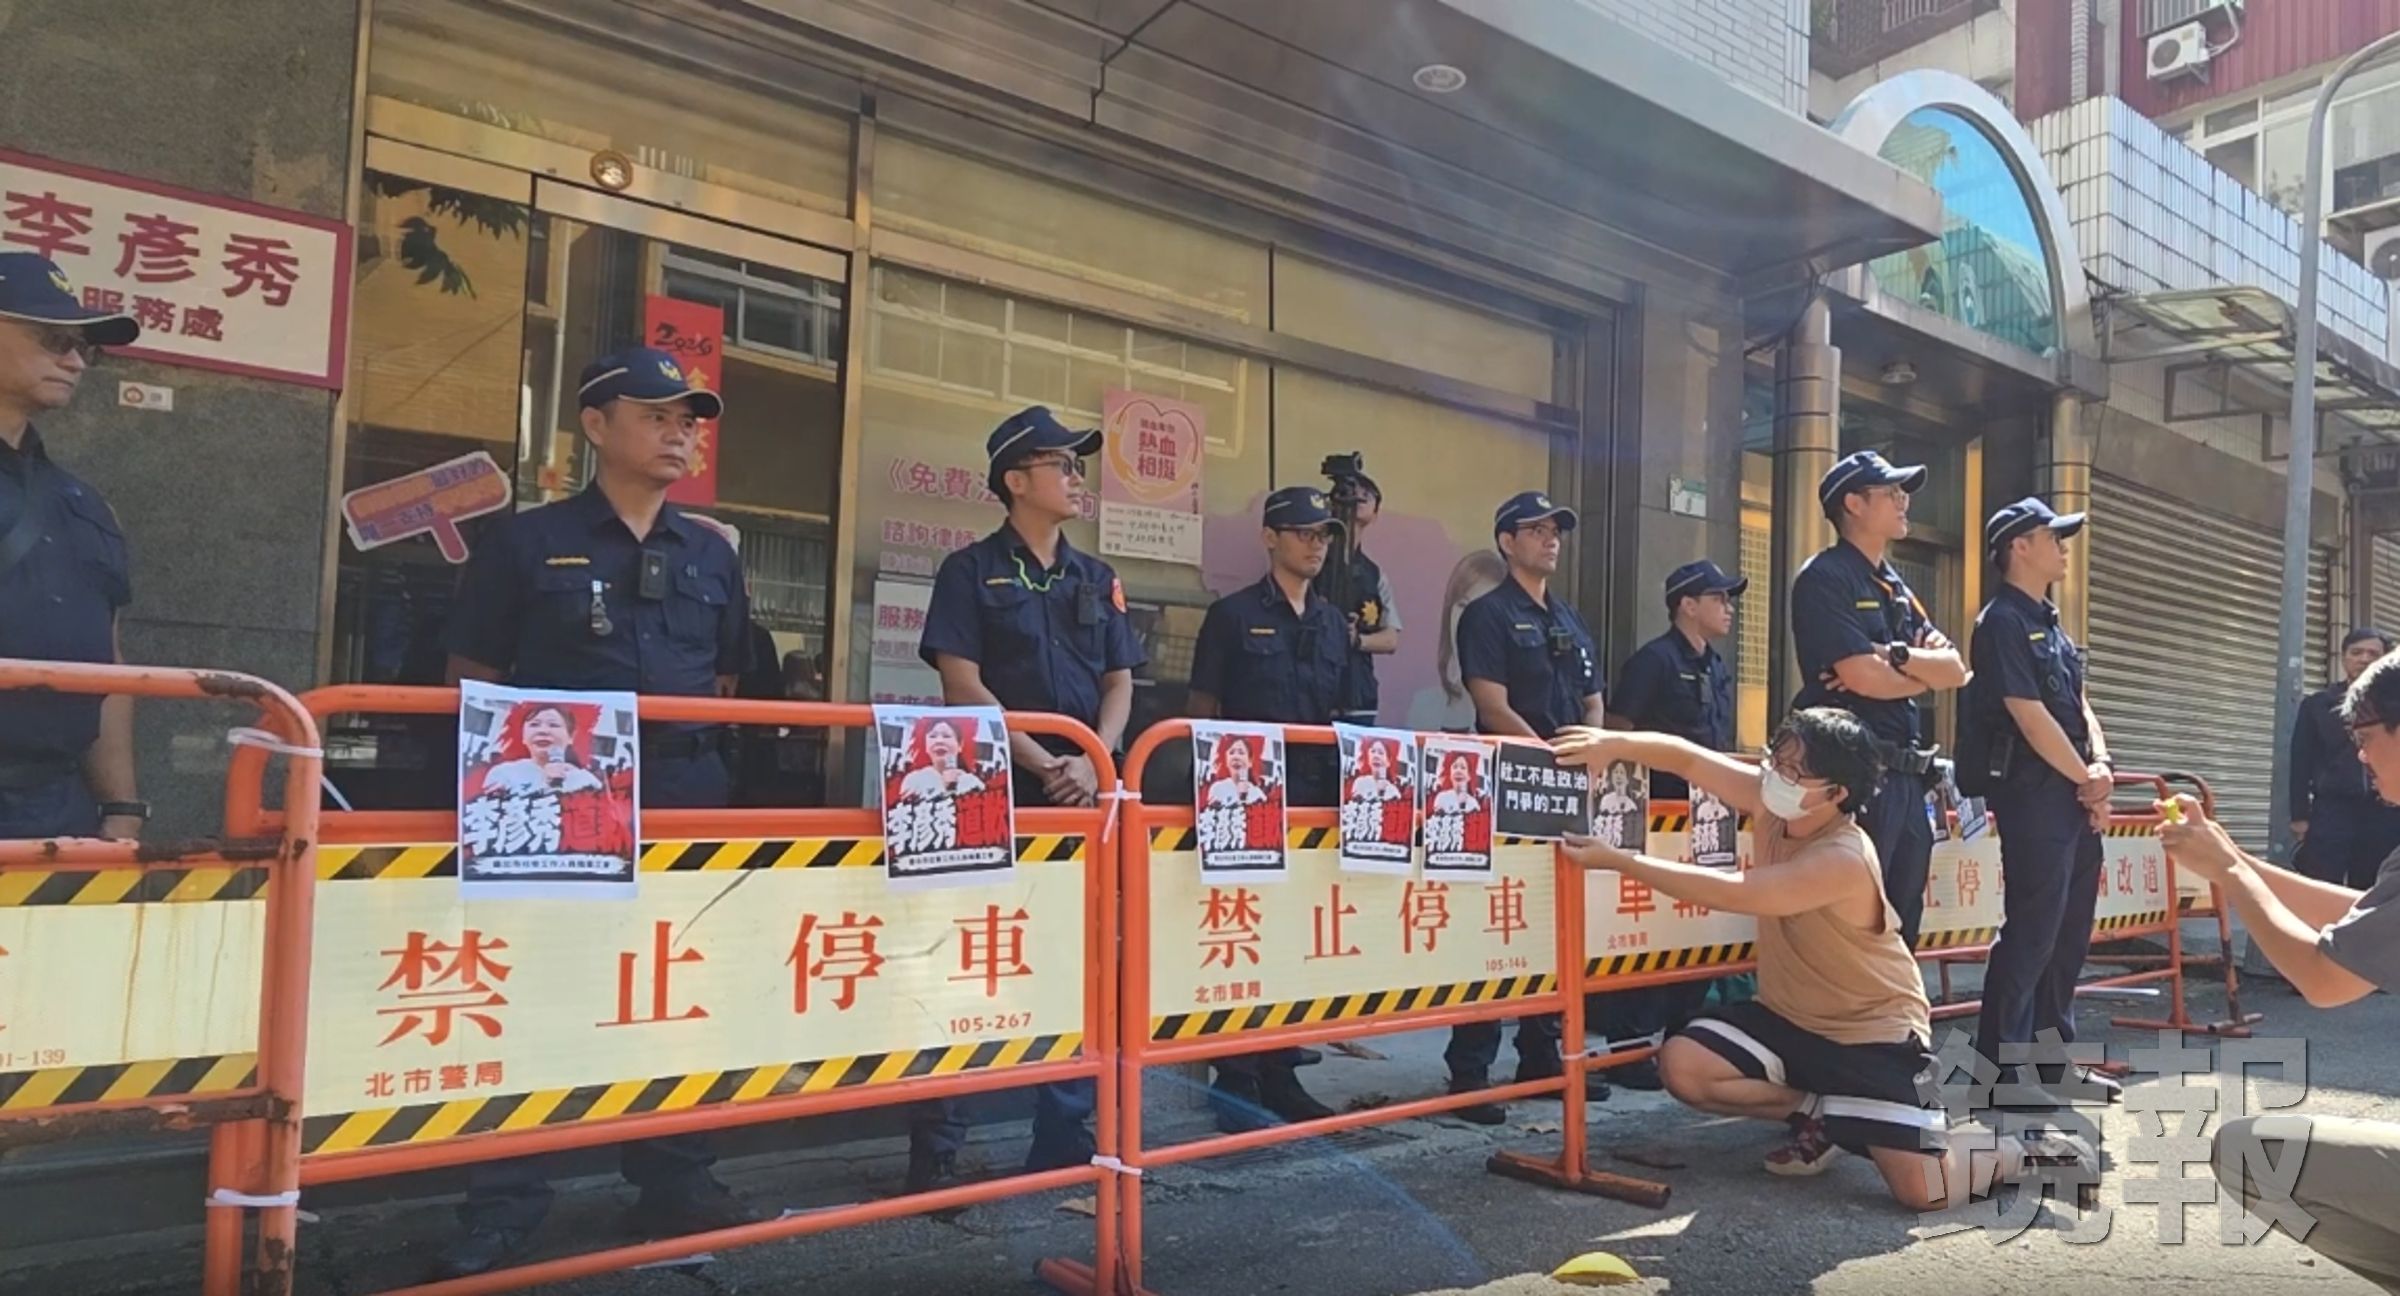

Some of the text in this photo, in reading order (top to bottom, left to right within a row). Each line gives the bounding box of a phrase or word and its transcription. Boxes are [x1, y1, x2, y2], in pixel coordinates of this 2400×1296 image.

[3, 192, 299, 307] 李彥秀
[83, 286, 224, 342] 服務處
[655, 322, 713, 356] 2026
[1138, 431, 1176, 457] 熱血
[1136, 454, 1176, 481] 相挺
[879, 605, 924, 629] 服務
[1501, 760, 1588, 791] 社工不是政治
[1505, 789, 1580, 816] 鬥爭的工具
[1198, 876, 1529, 969] 禁止停車
[377, 905, 1033, 1047] 禁止停車
[1194, 980, 1262, 1004] 北市警局
[365, 1061, 503, 1097] 北市警局
